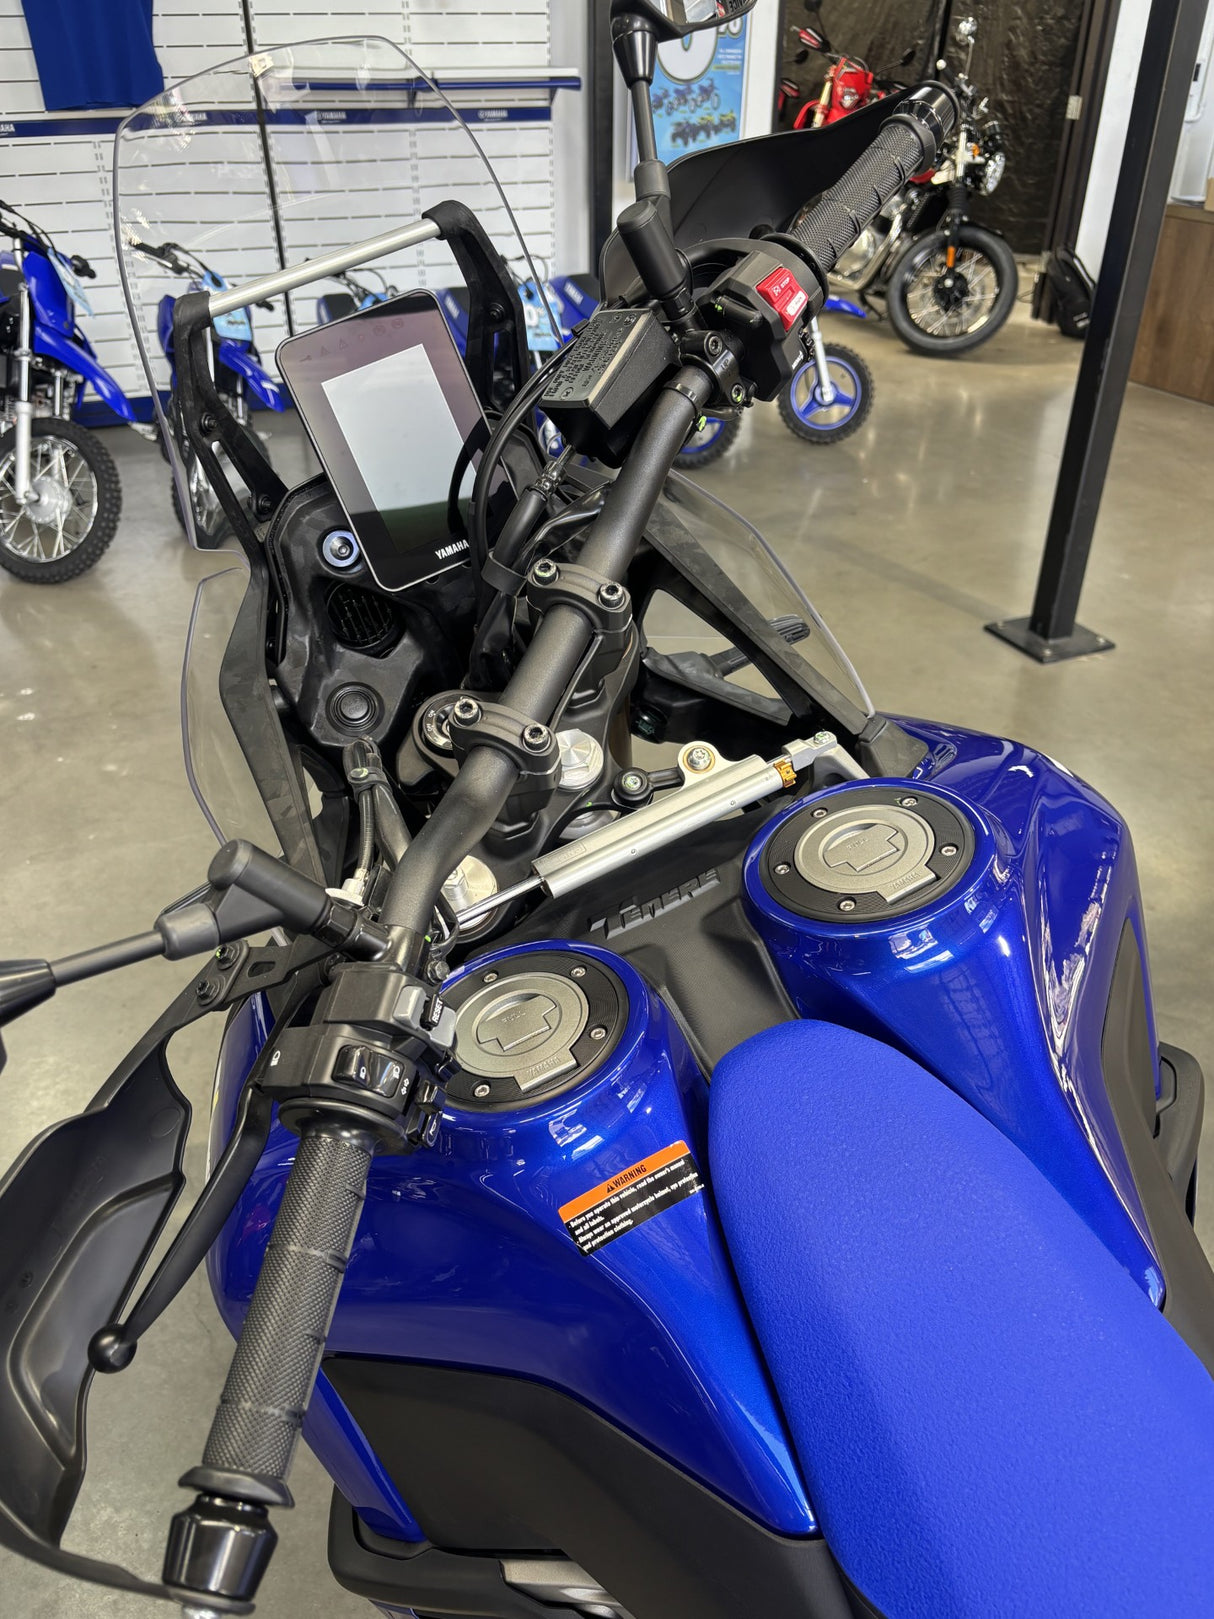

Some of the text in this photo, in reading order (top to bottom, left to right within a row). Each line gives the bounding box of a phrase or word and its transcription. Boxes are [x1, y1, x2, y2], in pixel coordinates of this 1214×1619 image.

[435, 539, 470, 560] YAMAHA
[890, 871, 920, 890] YAMAHA
[431, 997, 443, 1023] RESET
[526, 1055, 562, 1080] YAMAHA
[613, 1165, 646, 1187] WARNING
[636, 1179, 647, 1189] read
[592, 1225, 604, 1234] wear
[610, 1207, 632, 1224] approved
[630, 1195, 655, 1213] motorcycle
[574, 1226, 584, 1235] and
